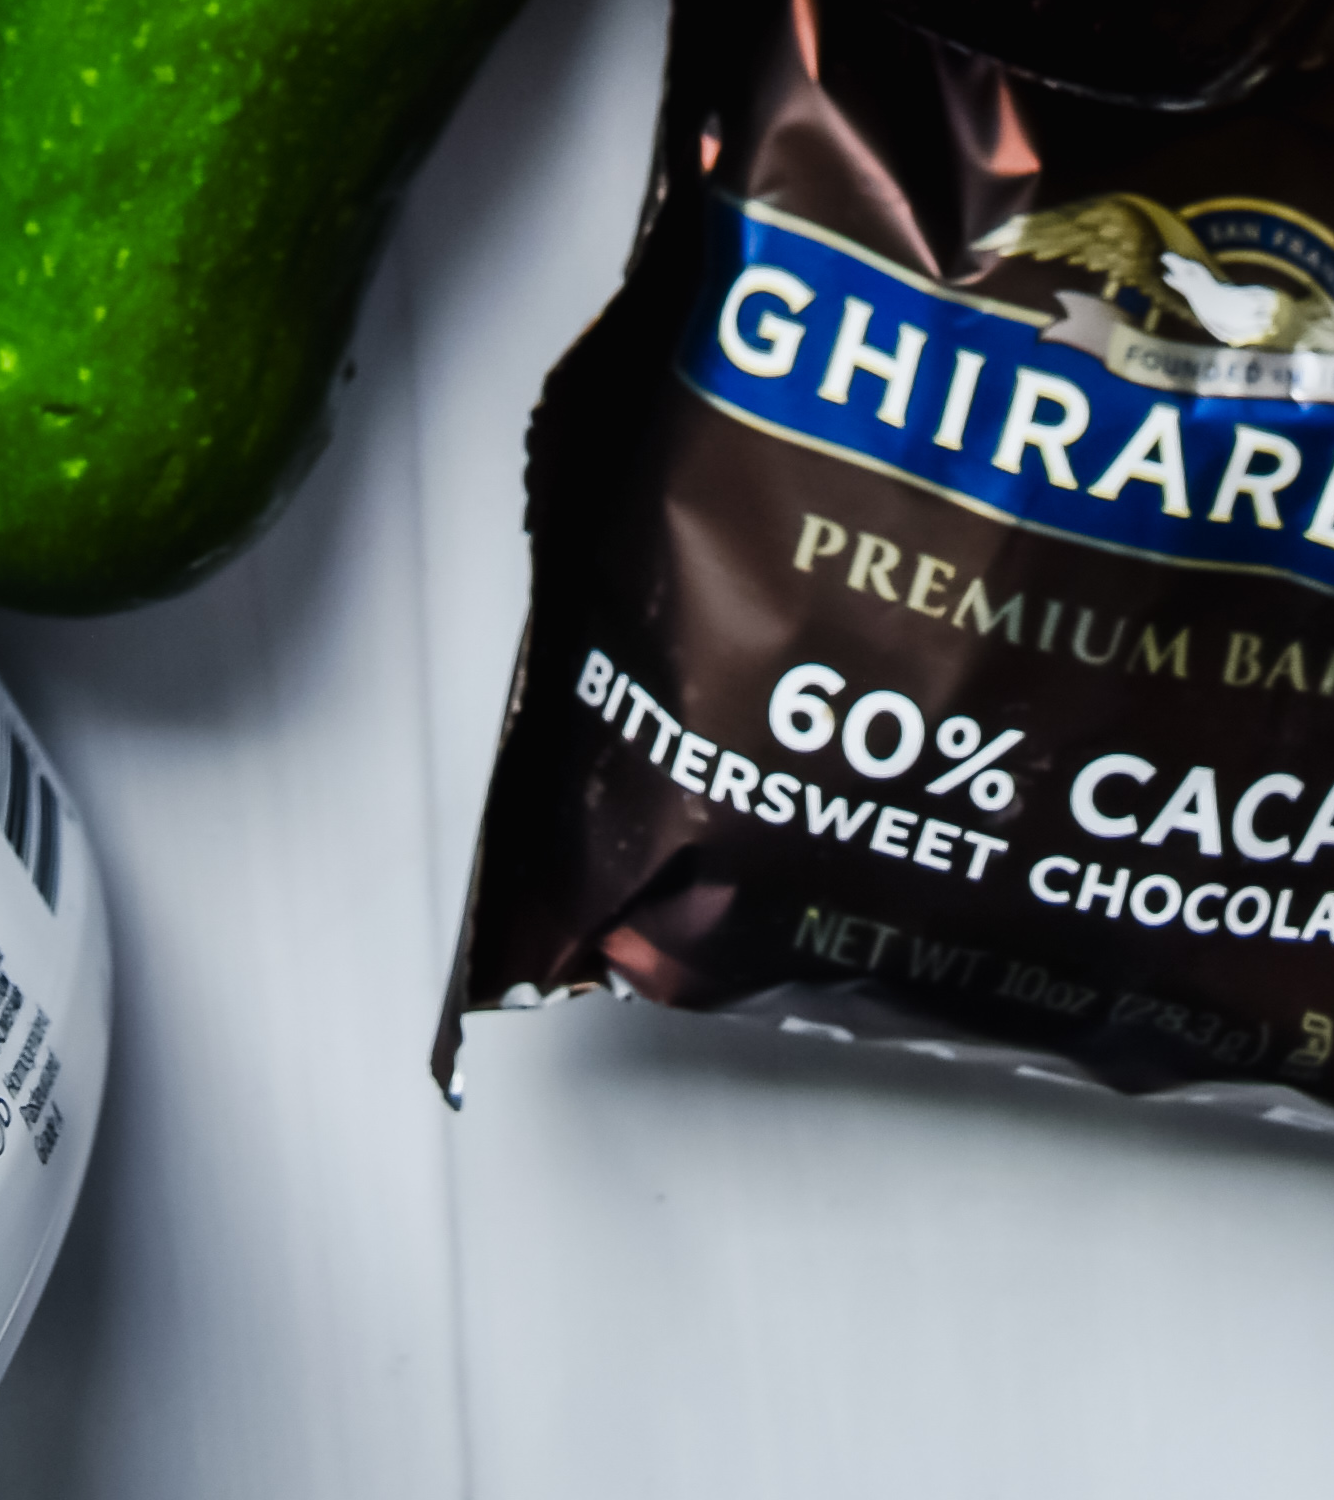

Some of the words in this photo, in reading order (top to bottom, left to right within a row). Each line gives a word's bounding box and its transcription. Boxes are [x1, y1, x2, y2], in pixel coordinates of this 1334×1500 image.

[789, 508, 1196, 681] PREMIUM
[572, 645, 1010, 884] BITTERSWEET
[764, 660, 1029, 817] 60%
